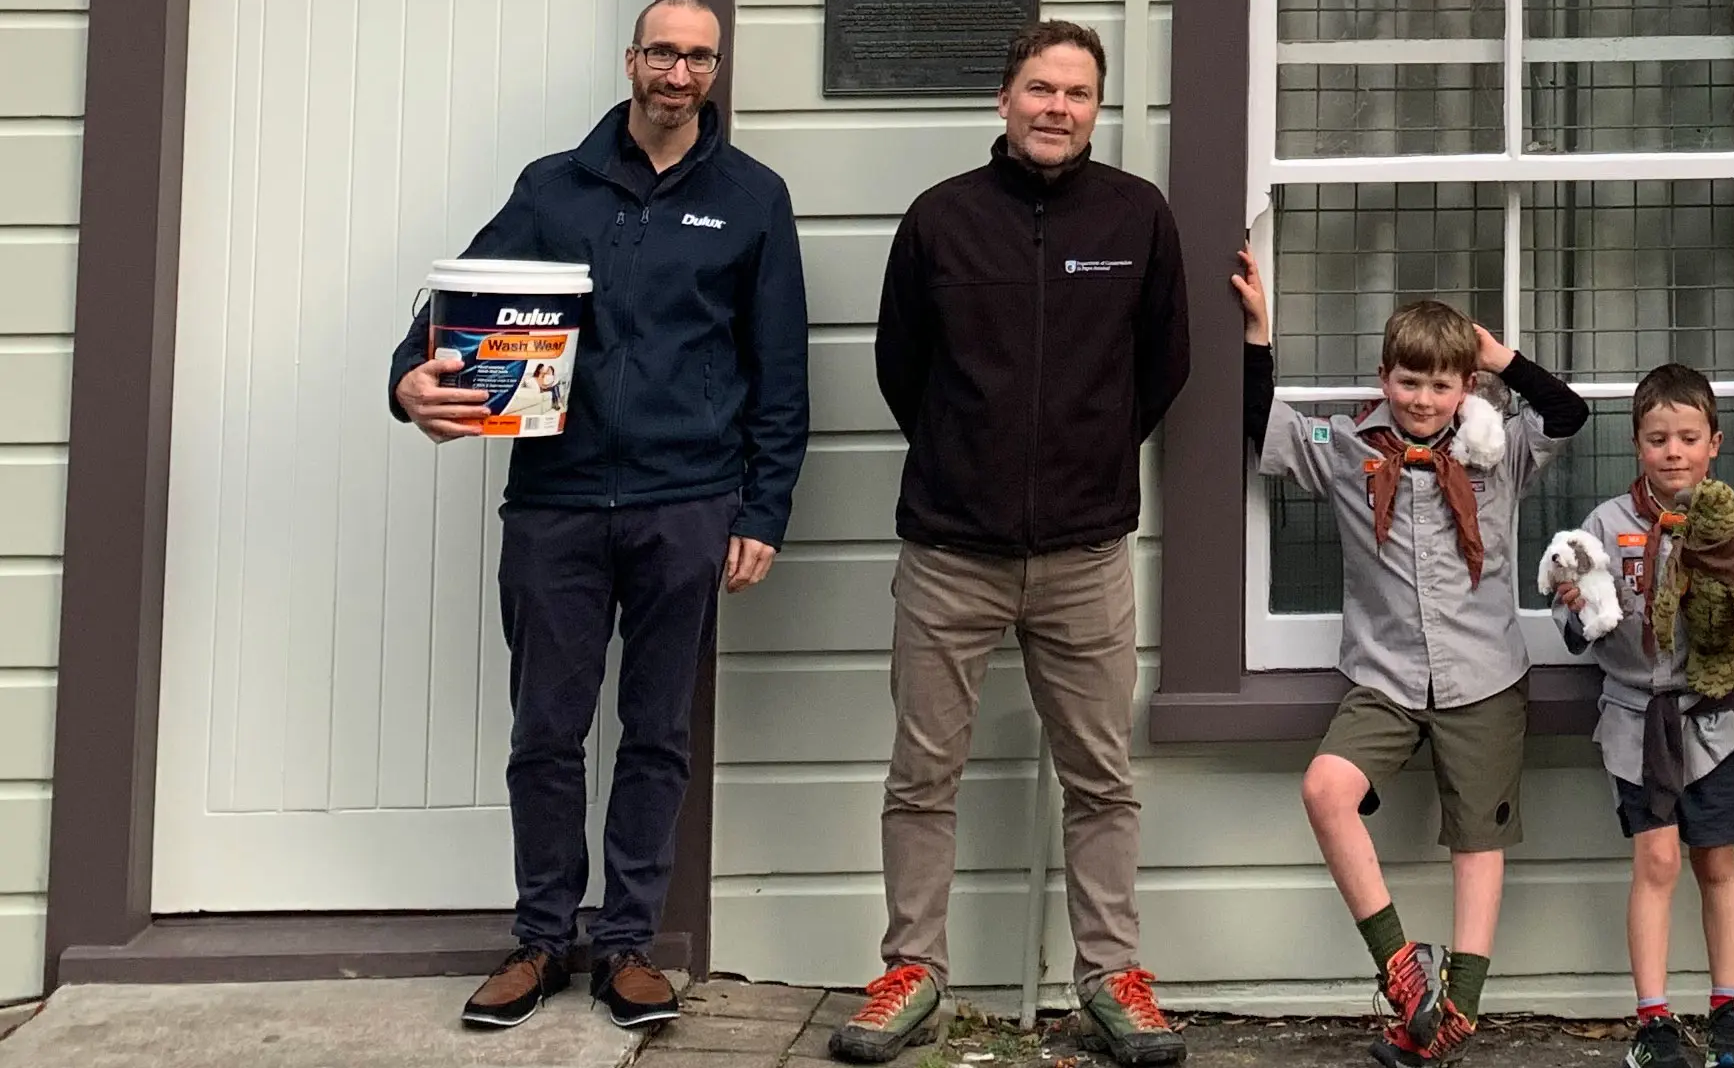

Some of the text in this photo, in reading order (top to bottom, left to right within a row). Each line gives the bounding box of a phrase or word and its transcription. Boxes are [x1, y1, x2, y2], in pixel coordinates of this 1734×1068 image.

[681, 213, 726, 229] Dulux
[496, 308, 563, 325] Dulux
[488, 339, 528, 352] Wash
